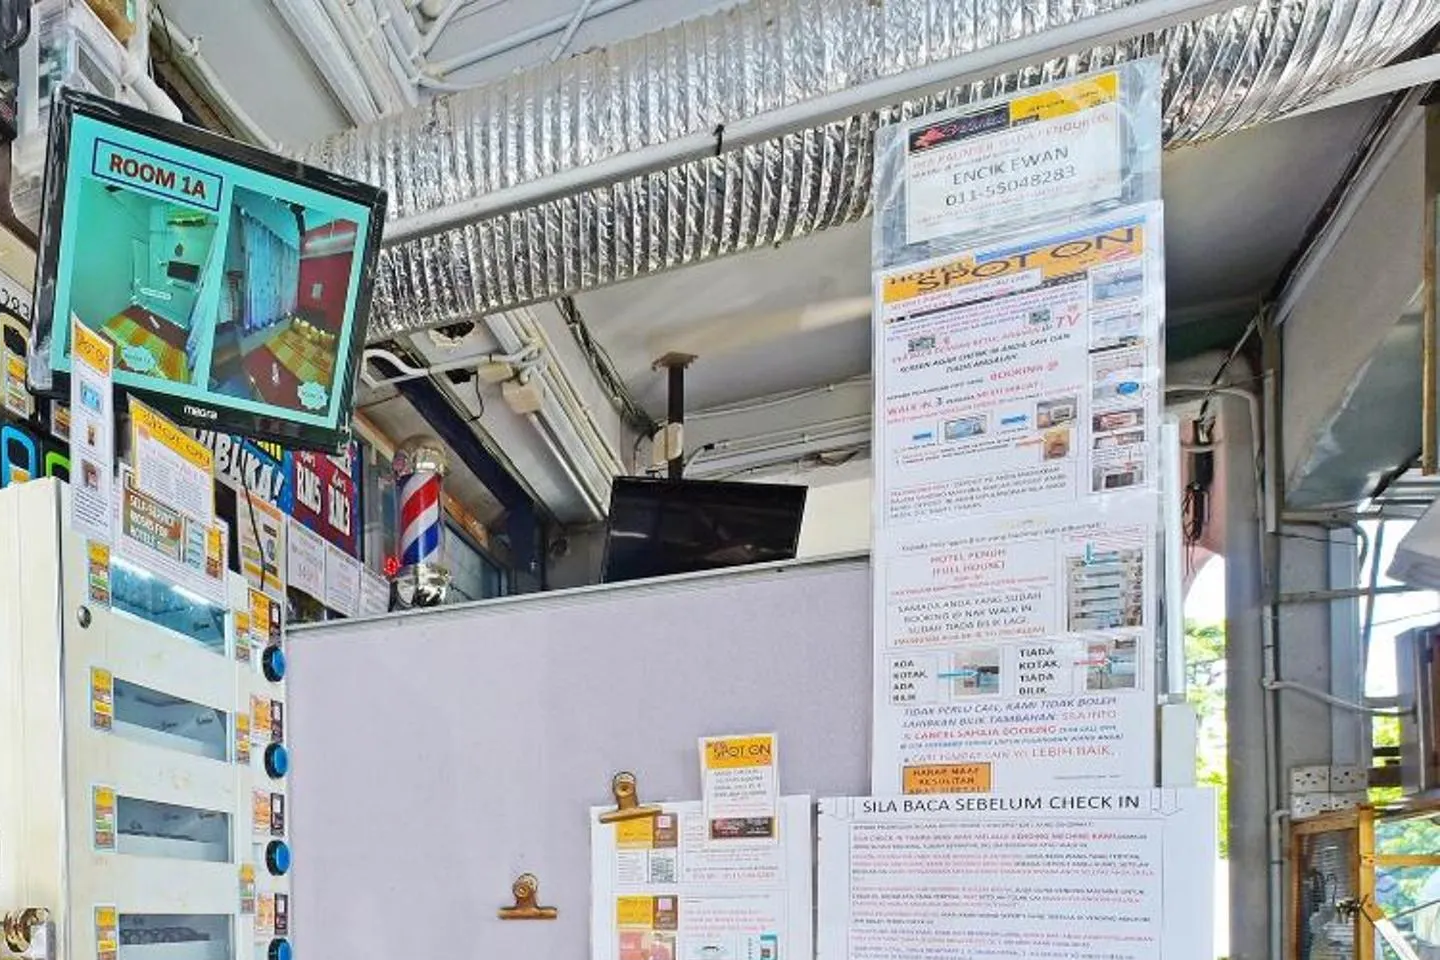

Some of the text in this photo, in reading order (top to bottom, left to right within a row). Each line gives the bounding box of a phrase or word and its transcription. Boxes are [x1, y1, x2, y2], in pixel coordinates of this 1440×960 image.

[109, 153, 207, 201] ROOM 1A
[952, 161, 1008, 185] ENCIK
[918, 228, 1134, 292] SPOT ON
[1019, 648, 1054, 658] TIADA
[1019, 673, 1054, 683] TIADA
[1018, 685, 1048, 696] BILIK
[1040, 699, 1075, 709] TIDAK
[1077, 696, 1118, 708] BOLEH
[1003, 725, 1057, 736] BOOKING
[749, 744, 771, 756] ON
[1032, 746, 1074, 758] LEBIH
[863, 795, 1140, 814] SILA BACA SEBELUM CHECK IN
